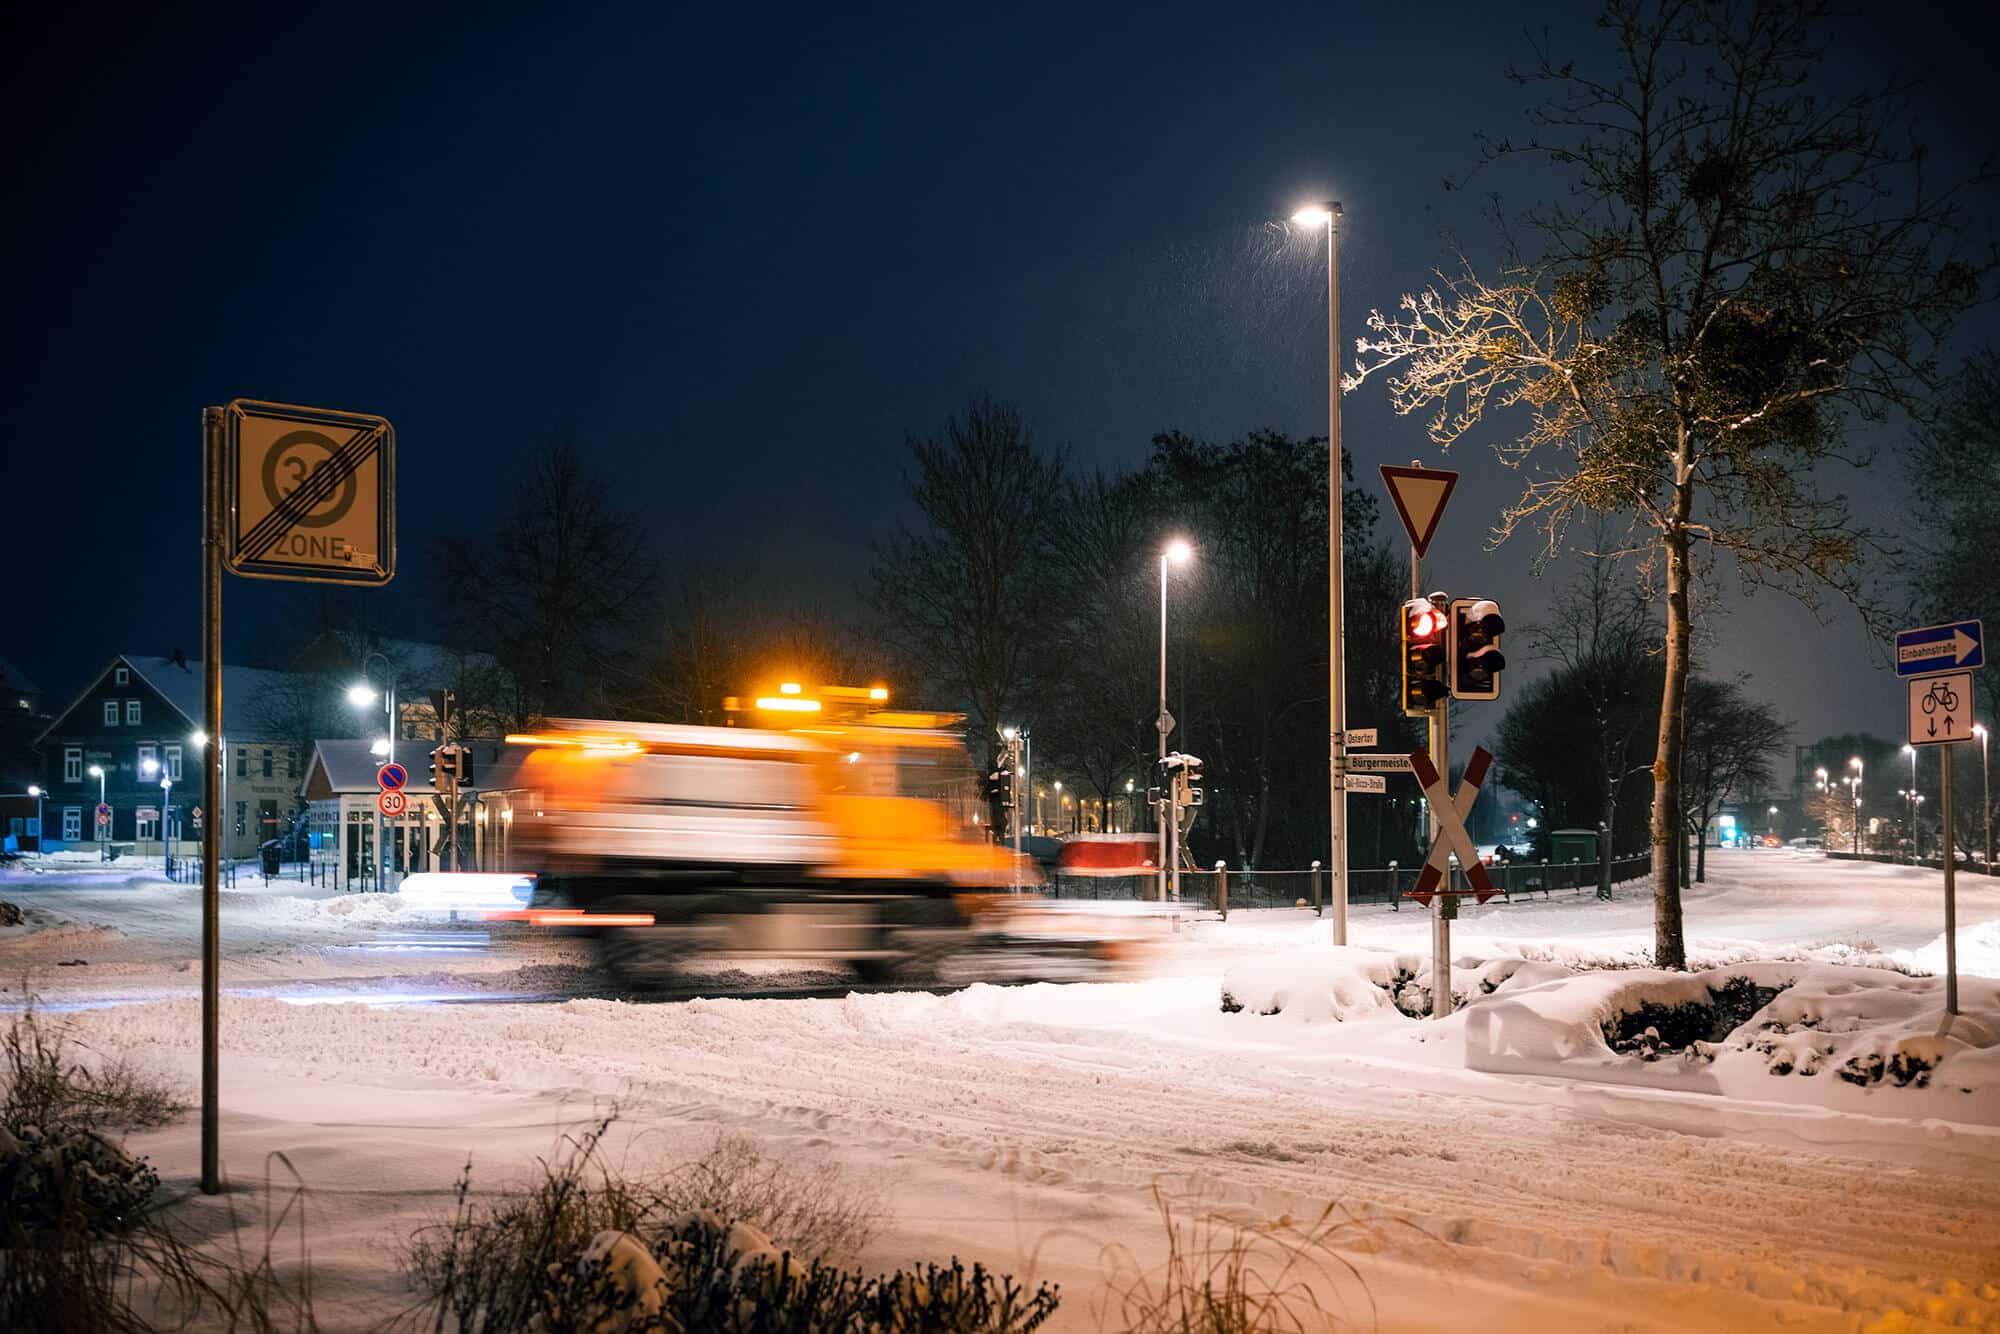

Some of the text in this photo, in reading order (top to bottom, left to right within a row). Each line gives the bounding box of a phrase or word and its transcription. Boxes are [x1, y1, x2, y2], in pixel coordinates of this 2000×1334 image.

[273, 534, 345, 560] ZONE
[1901, 642, 1957, 659] Einbahnstraße
[1347, 734, 1374, 744] Ostertor
[384, 796, 401, 809] 30
